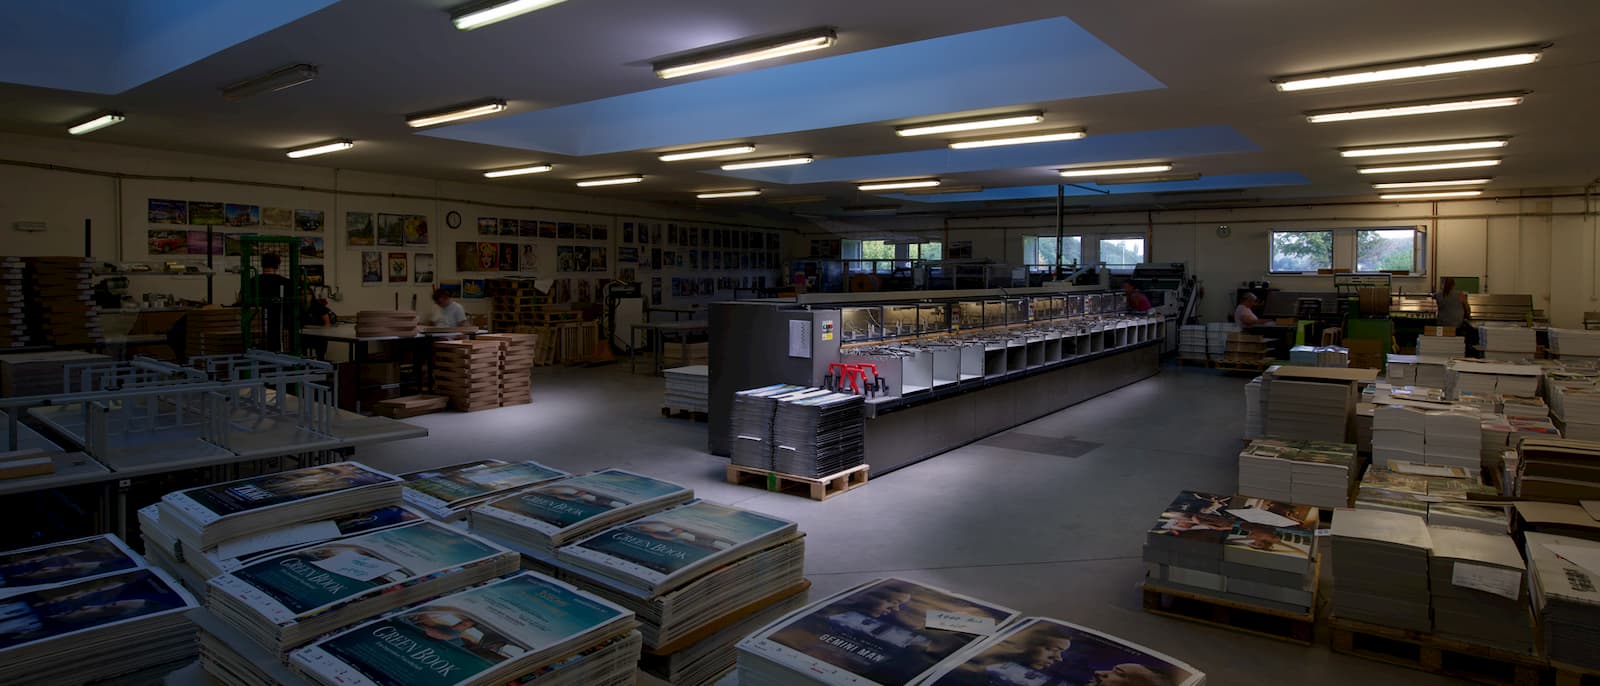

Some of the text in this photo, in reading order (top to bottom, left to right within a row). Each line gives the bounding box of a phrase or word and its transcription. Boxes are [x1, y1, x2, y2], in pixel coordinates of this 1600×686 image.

[372, 625, 418, 653] GREEN
[409, 647, 459, 678] BOOK
[819, 633, 857, 653] GEMINI
[857, 648, 885, 662] MAN
